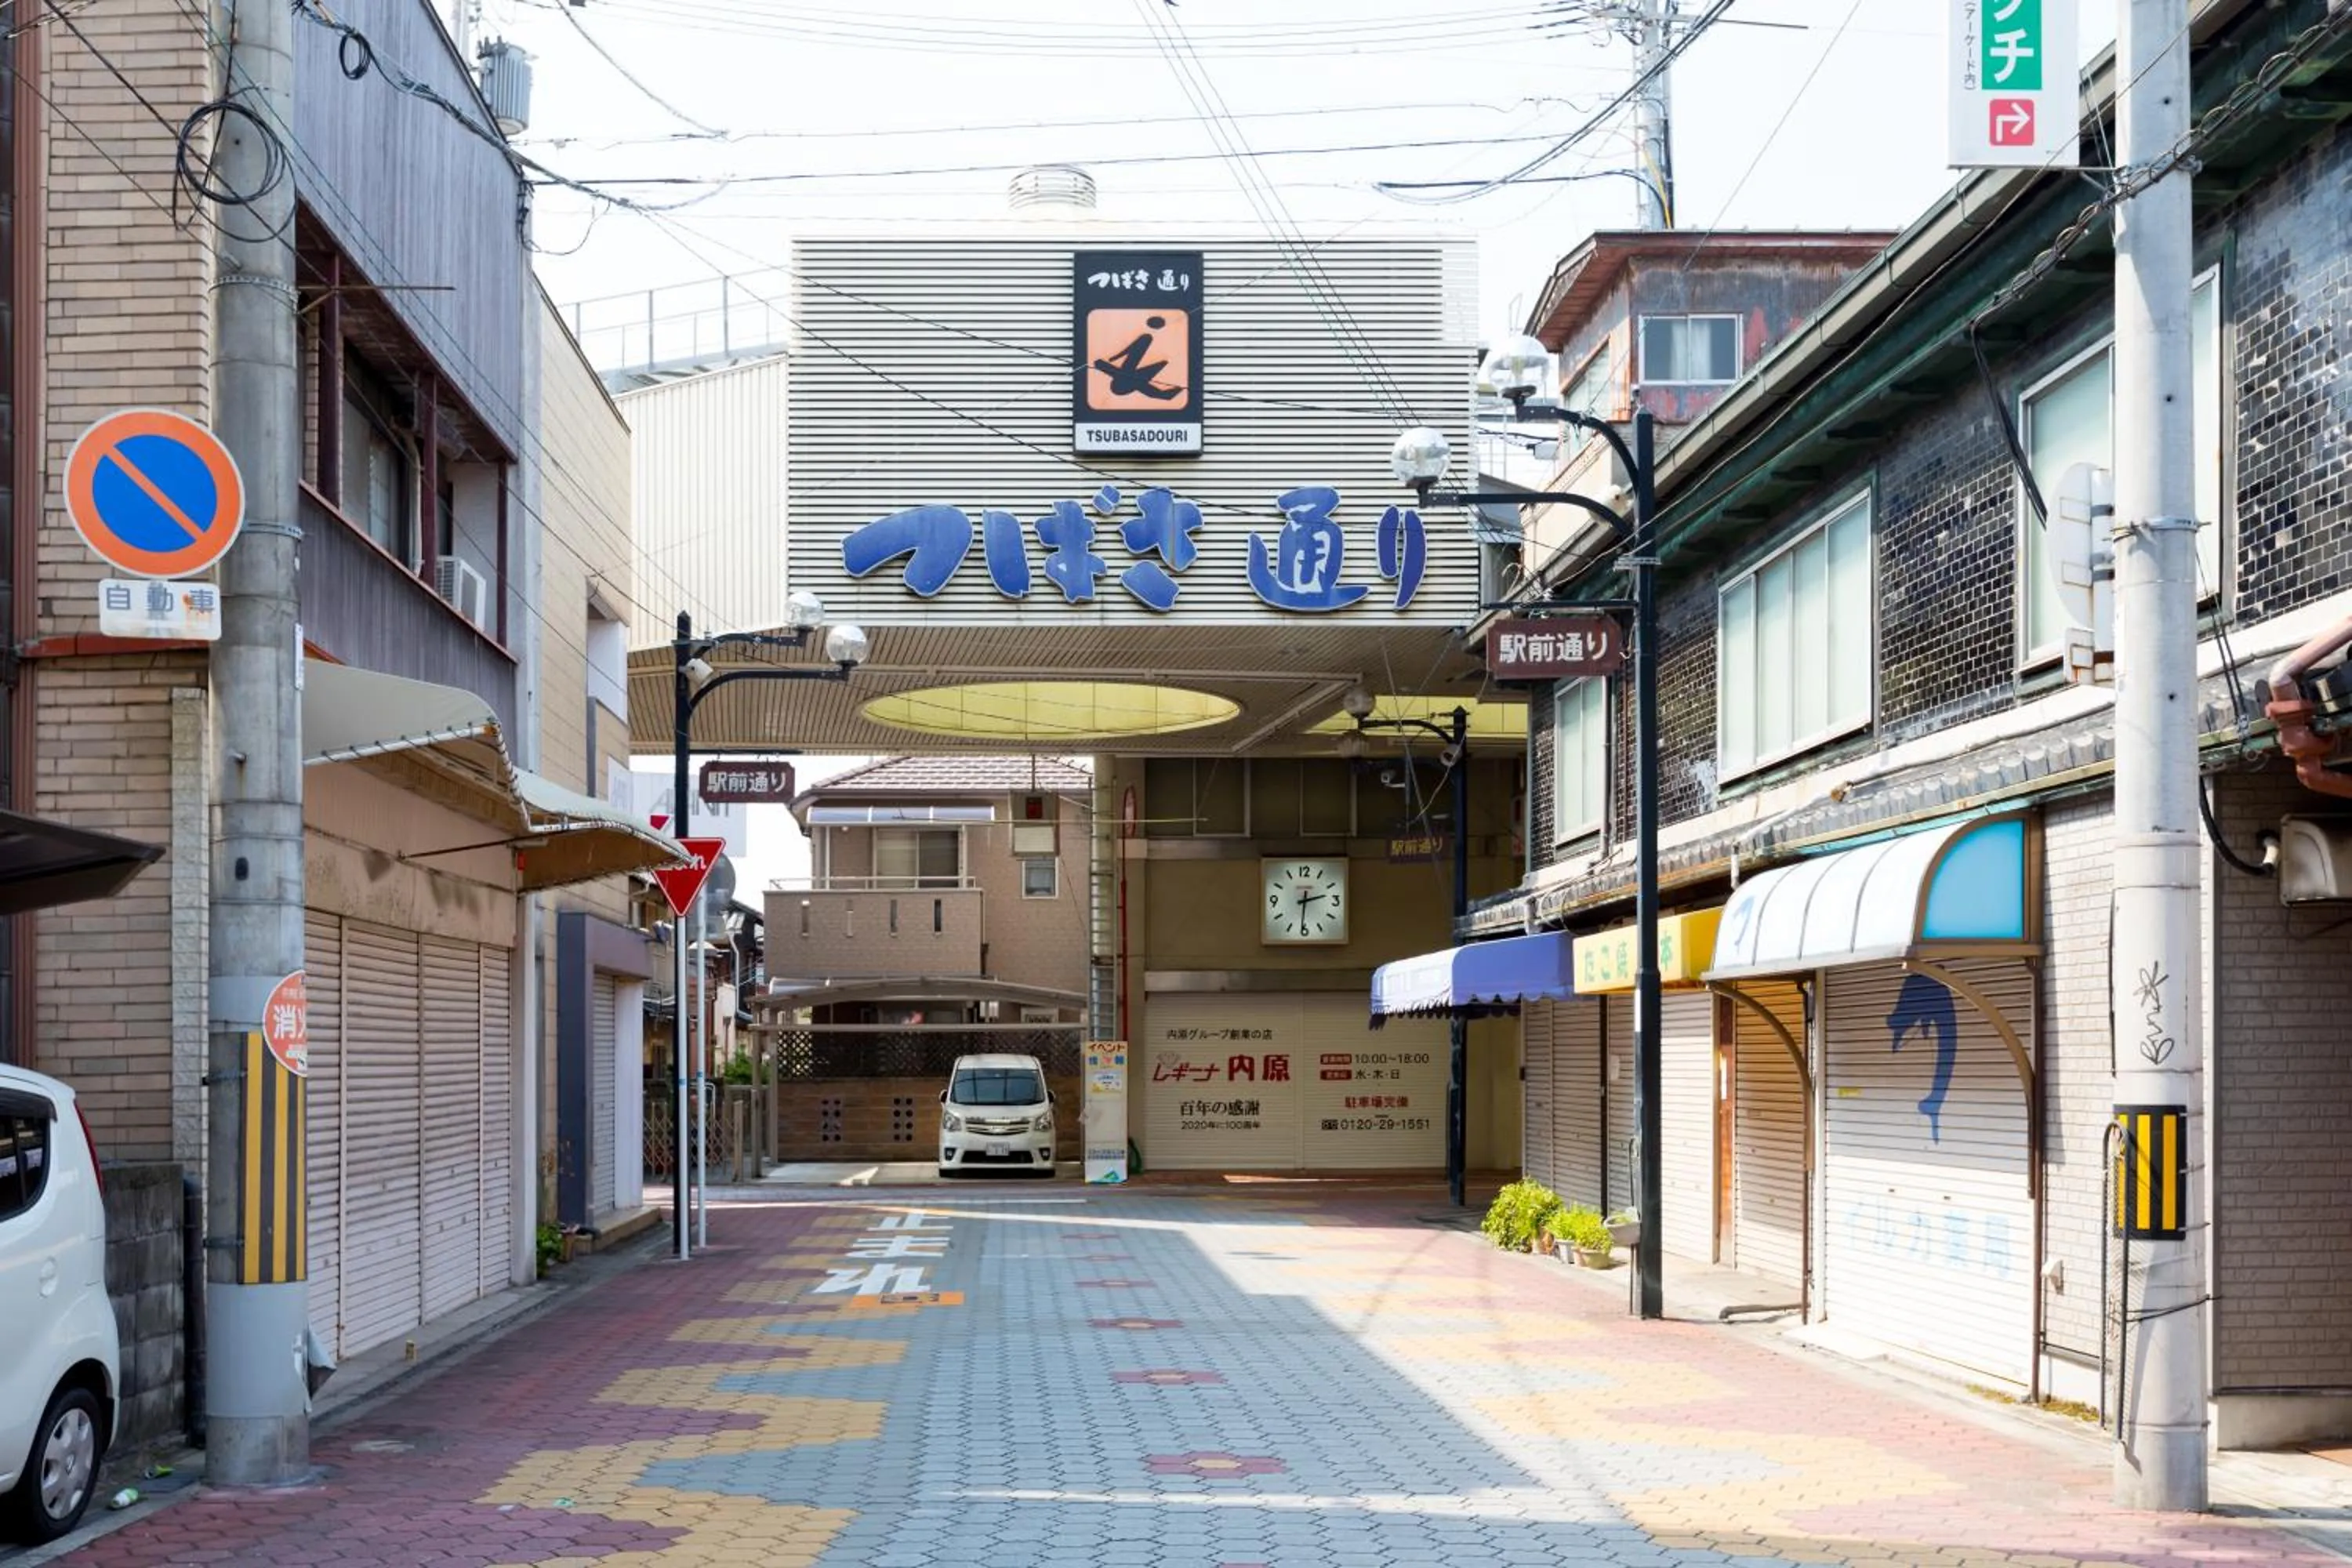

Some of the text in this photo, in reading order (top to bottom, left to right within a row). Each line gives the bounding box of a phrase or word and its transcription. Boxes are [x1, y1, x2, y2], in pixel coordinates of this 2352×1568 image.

[1086, 428, 1189, 444] TSUBASADOURI
[840, 486, 1428, 612] つばさ通り
[106, 584, 214, 615] 自動車
[1499, 631, 1607, 663] 駅前通り
[706, 770, 786, 793] 駅前通り
[1391, 836, 1443, 855] 駅前通り
[1299, 865, 1310, 878] 12
[1269, 895, 1279, 908] 9
[1331, 895, 1340, 907] 3
[1300, 923, 1309, 936] 6
[1584, 930, 1673, 983] たこ焼本
[1088, 1044, 1125, 1053] イベント
[1179, 1100, 1261, 1117] 百年の感謝
